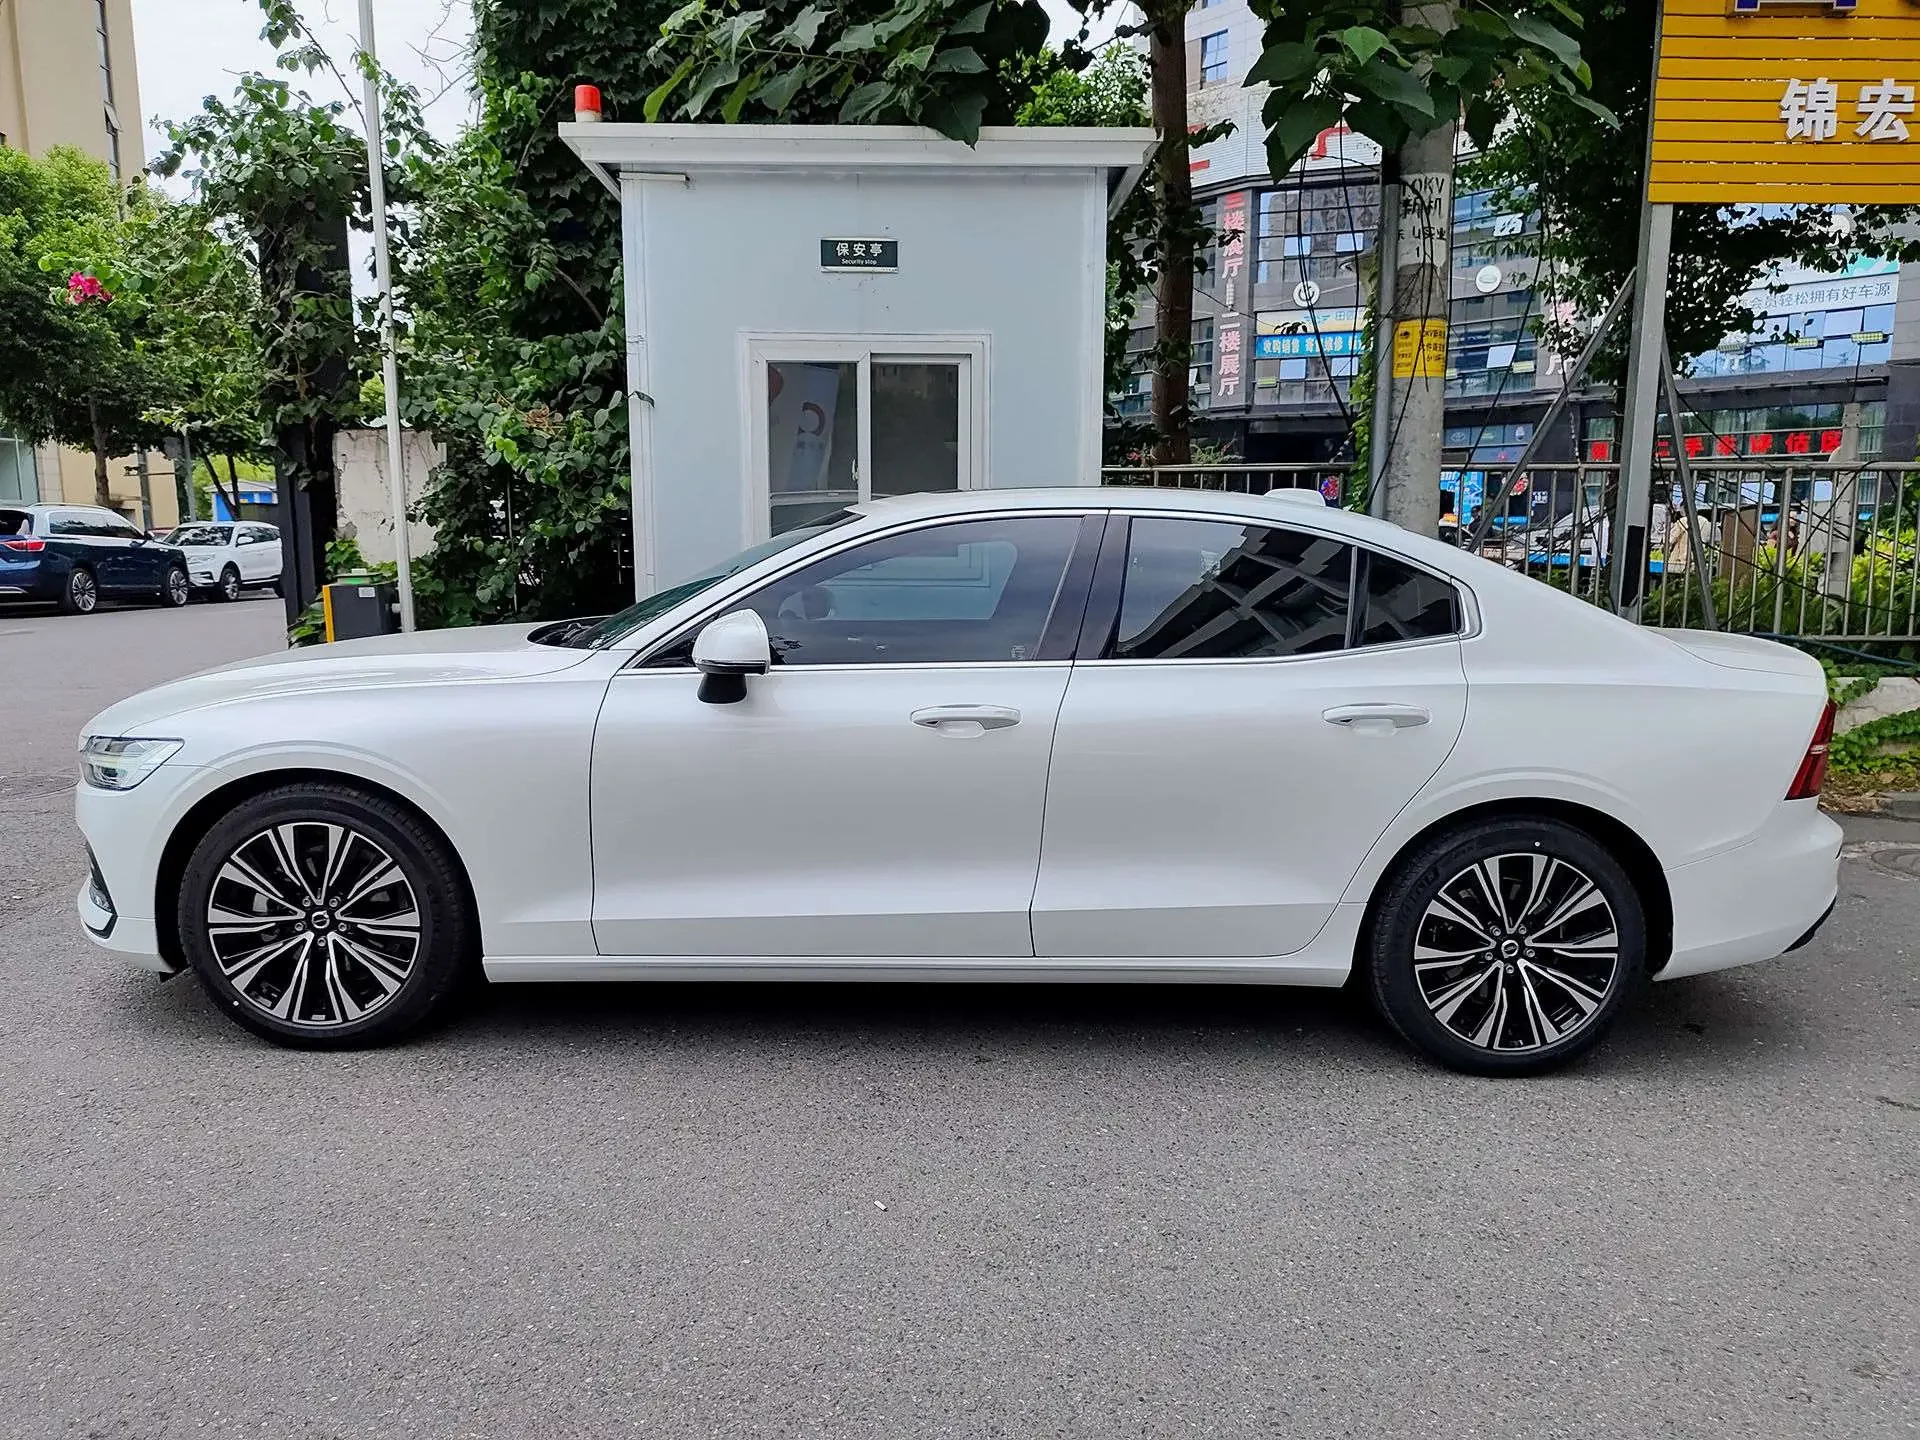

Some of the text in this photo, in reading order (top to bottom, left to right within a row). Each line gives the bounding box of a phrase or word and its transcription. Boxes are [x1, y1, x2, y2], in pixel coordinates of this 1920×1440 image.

[1779, 77, 1915, 142] 锦宏
[836, 242, 883, 257] 保安亭
[841, 258, 864, 266] Security
